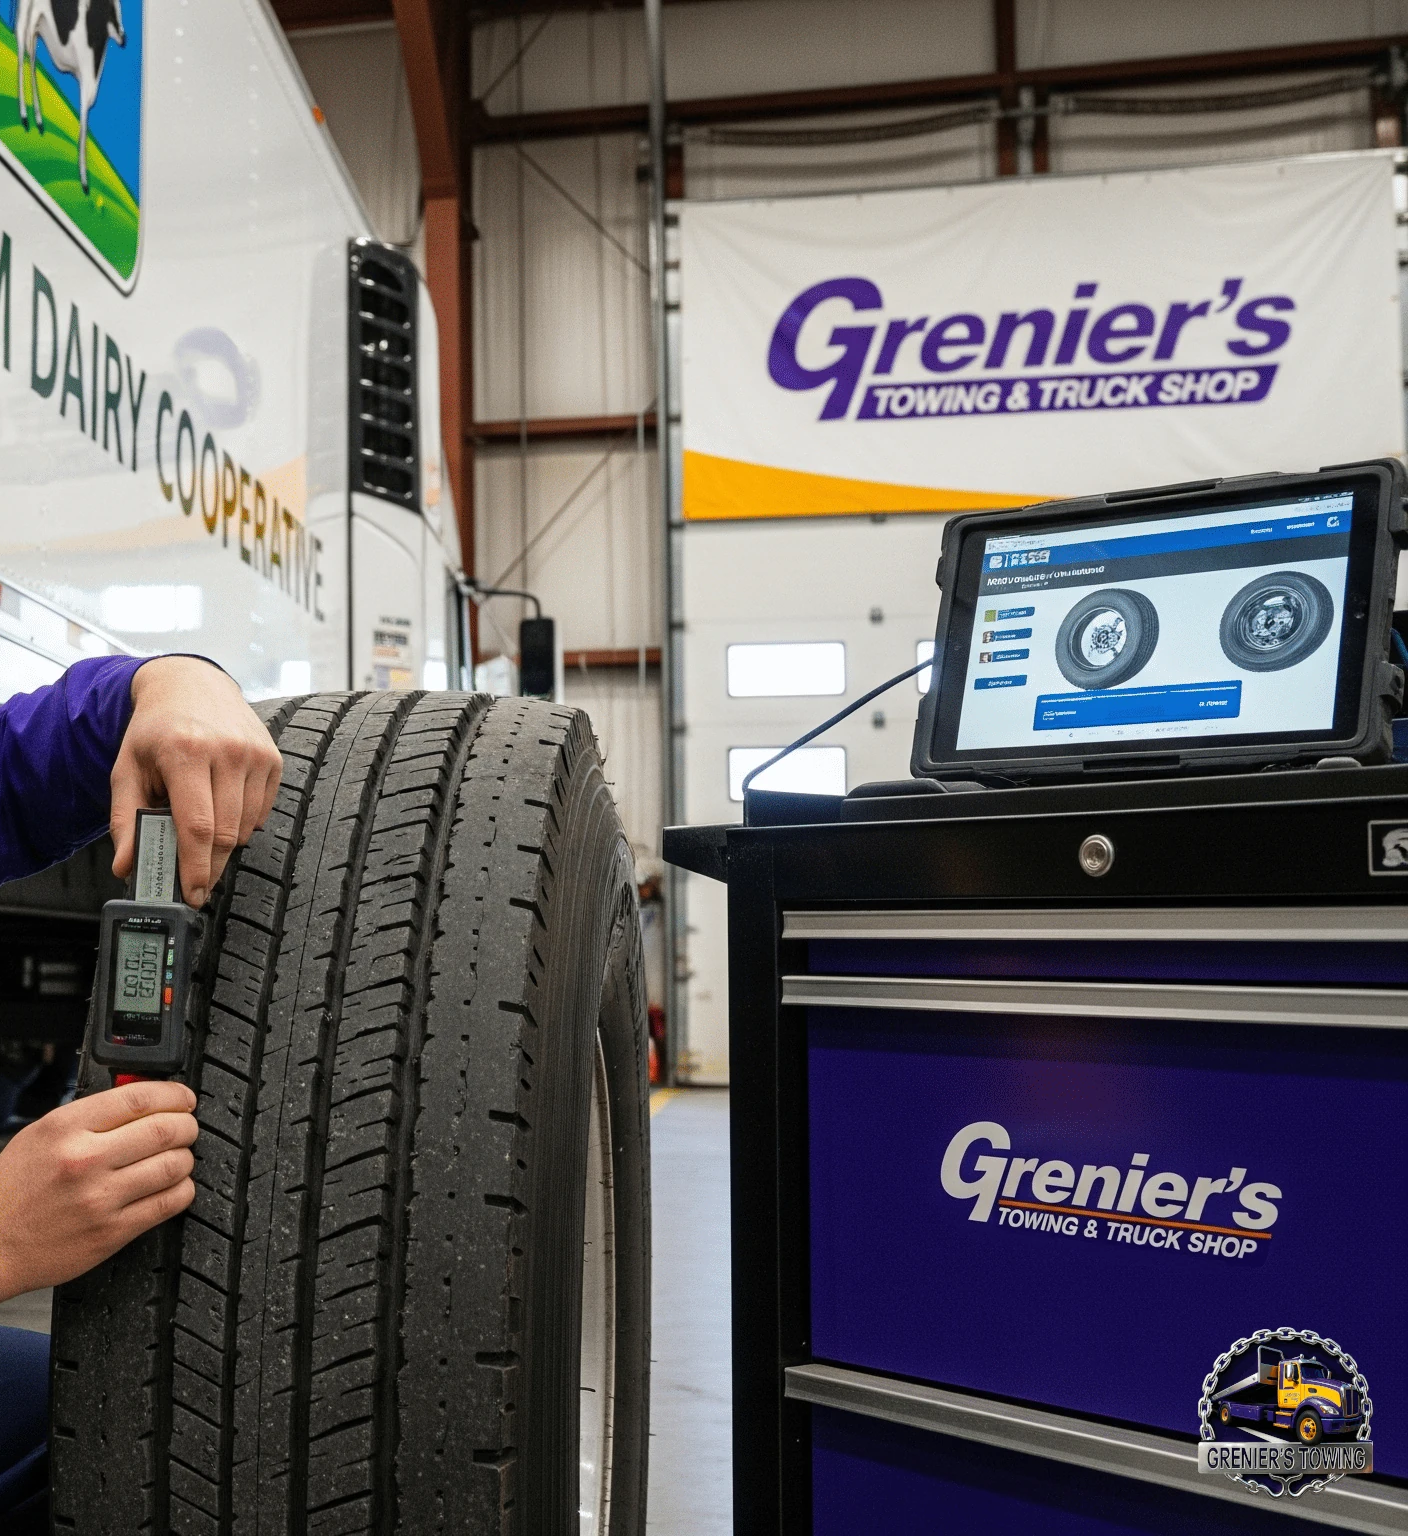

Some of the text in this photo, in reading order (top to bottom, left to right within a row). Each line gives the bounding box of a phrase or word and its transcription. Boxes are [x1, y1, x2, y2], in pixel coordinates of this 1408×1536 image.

[768, 277, 1295, 421] Grenier's
[873, 369, 1260, 416] TOWING & TRUCK SHOP
[31, 264, 146, 473] DAIRY
[156, 390, 325, 623] COOPERATIVE
[940, 1121, 1283, 1230] Grenier's
[998, 1207, 1258, 1259] TOWING & TRUCK SHOP
